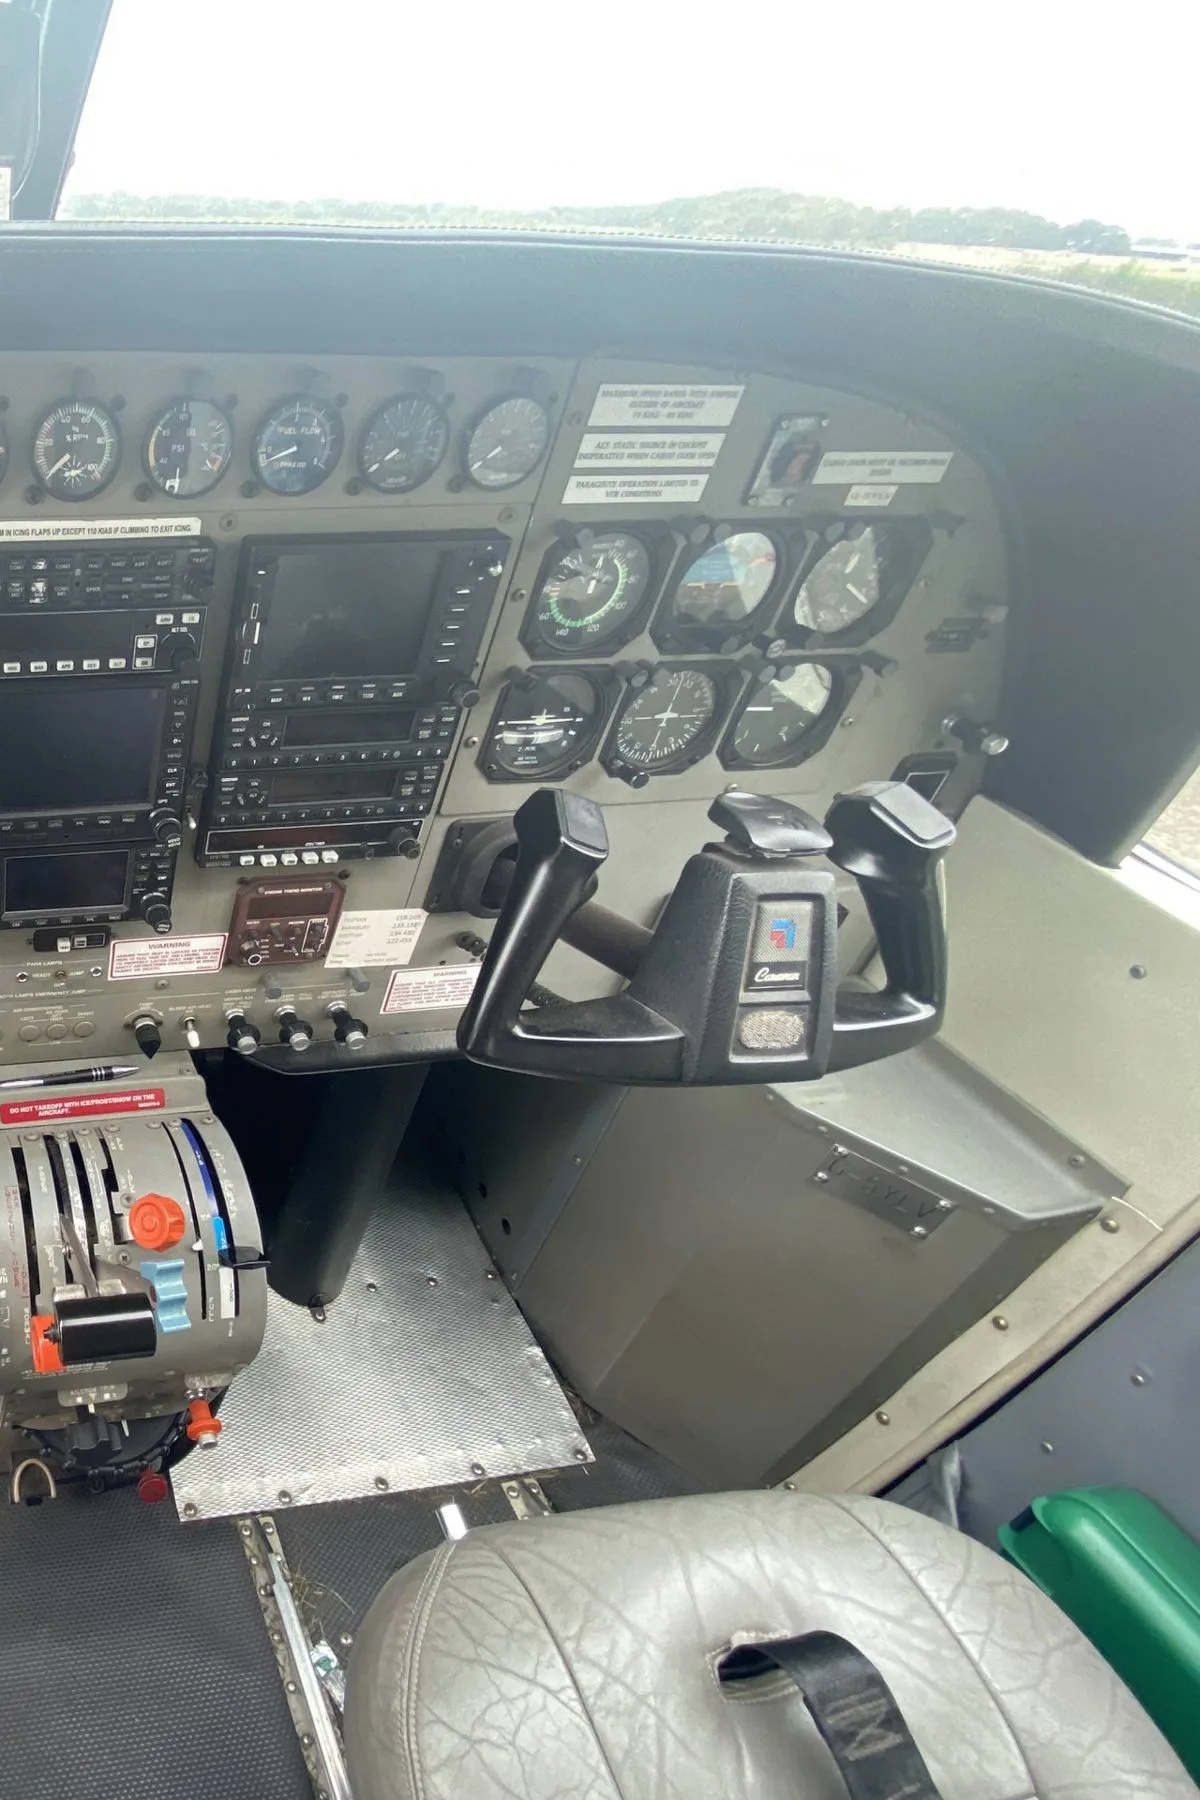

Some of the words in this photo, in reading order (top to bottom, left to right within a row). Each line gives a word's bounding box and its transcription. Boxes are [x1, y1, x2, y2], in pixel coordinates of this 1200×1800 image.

[6, 528, 12, 536] IN
[13, 527, 30, 536] ICING
[31, 527, 51, 536] FLAPS
[52, 527, 60, 535] UP
[61, 526, 86, 535] EXCEPT
[160, 525, 173, 533] EXIT
[148, 941, 191, 950] WARNING
[35, 1102, 63, 1112] TAKEOFF
[38, 1108, 71, 1117] AIRCRAFT.
